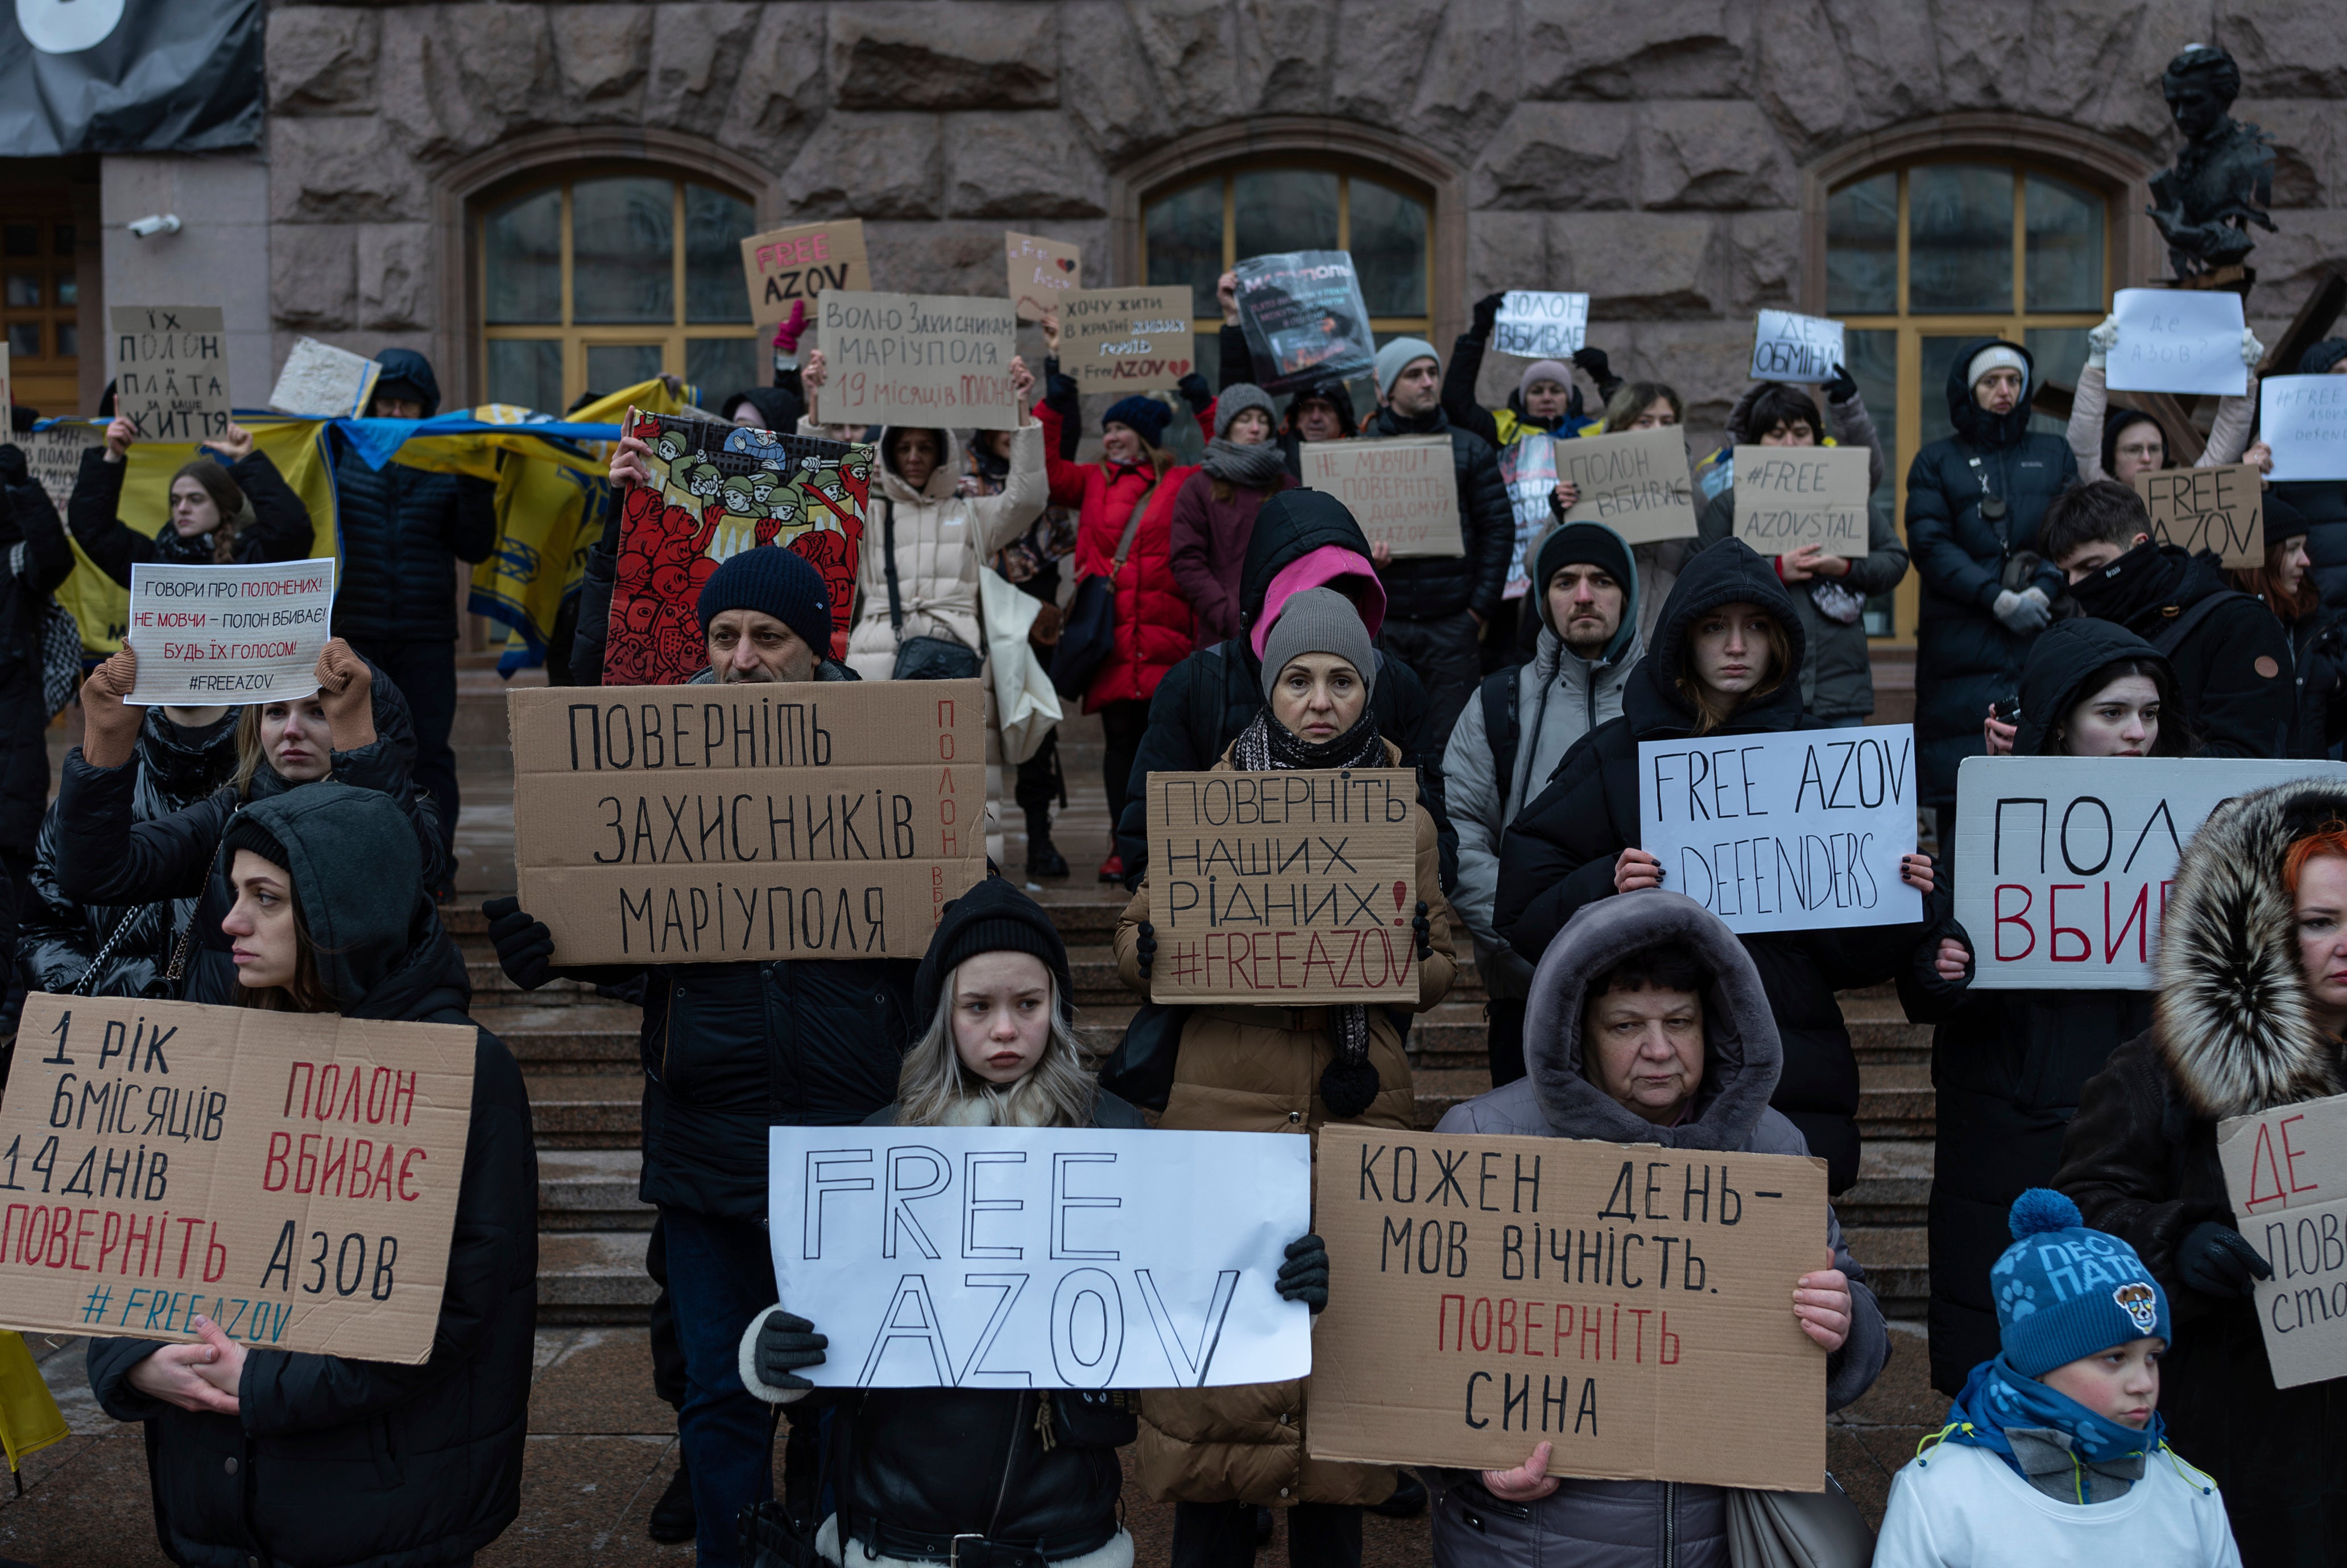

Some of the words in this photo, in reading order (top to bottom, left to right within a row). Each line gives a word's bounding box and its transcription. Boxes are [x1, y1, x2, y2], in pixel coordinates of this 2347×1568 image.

[756, 233, 829, 274] FREE
[765, 263, 849, 305] AZOV
[1066, 300, 1112, 317] ХОЧУ
[1117, 297, 1162, 312] ЖИТИ
[147, 309, 181, 330] ЇХ
[827, 302, 902, 331] ВОЛЮ
[1064, 324, 1075, 338] В
[1777, 317, 1817, 342] ДЕ
[120, 333, 220, 361] ПОЛОН
[839, 336, 997, 366] МАРІУПОЛЯ
[147, 401, 159, 411] ЗА
[172, 400, 203, 411] ВАШЕ
[835, 372, 867, 407] 19
[126, 410, 227, 438] ЖИТТЯ
[1315, 452, 1340, 478] НЕ
[1355, 448, 1428, 475] МОВЧИ!
[1570, 447, 1650, 486] ПОЛОН
[1747, 460, 1829, 493] #FREE
[1343, 477, 1448, 501] ПОВЕРНІТЬ
[1368, 498, 1449, 524] ДОДОМУ!
[2149, 470, 2238, 517] FREE
[1744, 510, 1861, 539] AZOVSTAL
[2153, 508, 2257, 557] AZOV
[145, 581, 204, 597] ГОВОРИ
[208, 582, 237, 597] ПРО
[241, 578, 322, 597] ПОЛОНЕНИХ!
[135, 612, 154, 627] НЕ
[158, 613, 205, 627] МОВЧИ
[223, 613, 269, 628] ПОЛОН
[272, 607, 326, 626] ВБИВАЄ!
[164, 643, 204, 662] БУДЬ
[209, 639, 227, 660] ЇХ
[231, 640, 297, 659] ГОЛОСОМ!
[189, 674, 274, 690] #FREEAZOV
[569, 697, 832, 771] ПОВЕРНІТЬ
[938, 700, 957, 856] ПОЛОН
[1165, 771, 1407, 826] ПОВЕРНІТЬ
[1654, 746, 1768, 822] FREE
[1795, 738, 1910, 813] AZOV
[593, 788, 915, 864] ЗАХИСНИКІВ
[1994, 796, 2241, 876] ПОЛ
[1166, 836, 1358, 876] НАШИХ
[1681, 832, 1877, 915] DEFENDERS
[619, 882, 887, 953] МАРІУПОЛЯ
[1994, 880, 2177, 965] ВБИ
[1170, 927, 1418, 989] #FREEAZOV
[42, 1010, 76, 1065] 1
[98, 1015, 179, 1075] РІК
[283, 1060, 417, 1127] ПОЛОН
[263, 1131, 428, 1203] ВБИВАЄ
[1359, 1143, 1542, 1214] КОЖЕН
[2245, 1114, 2319, 1214] ДЕ
[802, 1145, 1121, 1261] FREE
[0, 1202, 227, 1284] ПОВЕРНІТЬ
[260, 1219, 399, 1302] АЗОВ
[1380, 1215, 1468, 1279] МОВ
[2037, 1236, 2115, 1272] ПЕС
[2266, 1213, 2347, 1281] ПОВ
[2046, 1255, 2150, 1302] ПАТР
[855, 1267, 1240, 1388] AZOV
[1438, 1293, 1680, 1366] ПОВЕРНІТЬ
[1464, 1371, 1599, 1437] СИНА
